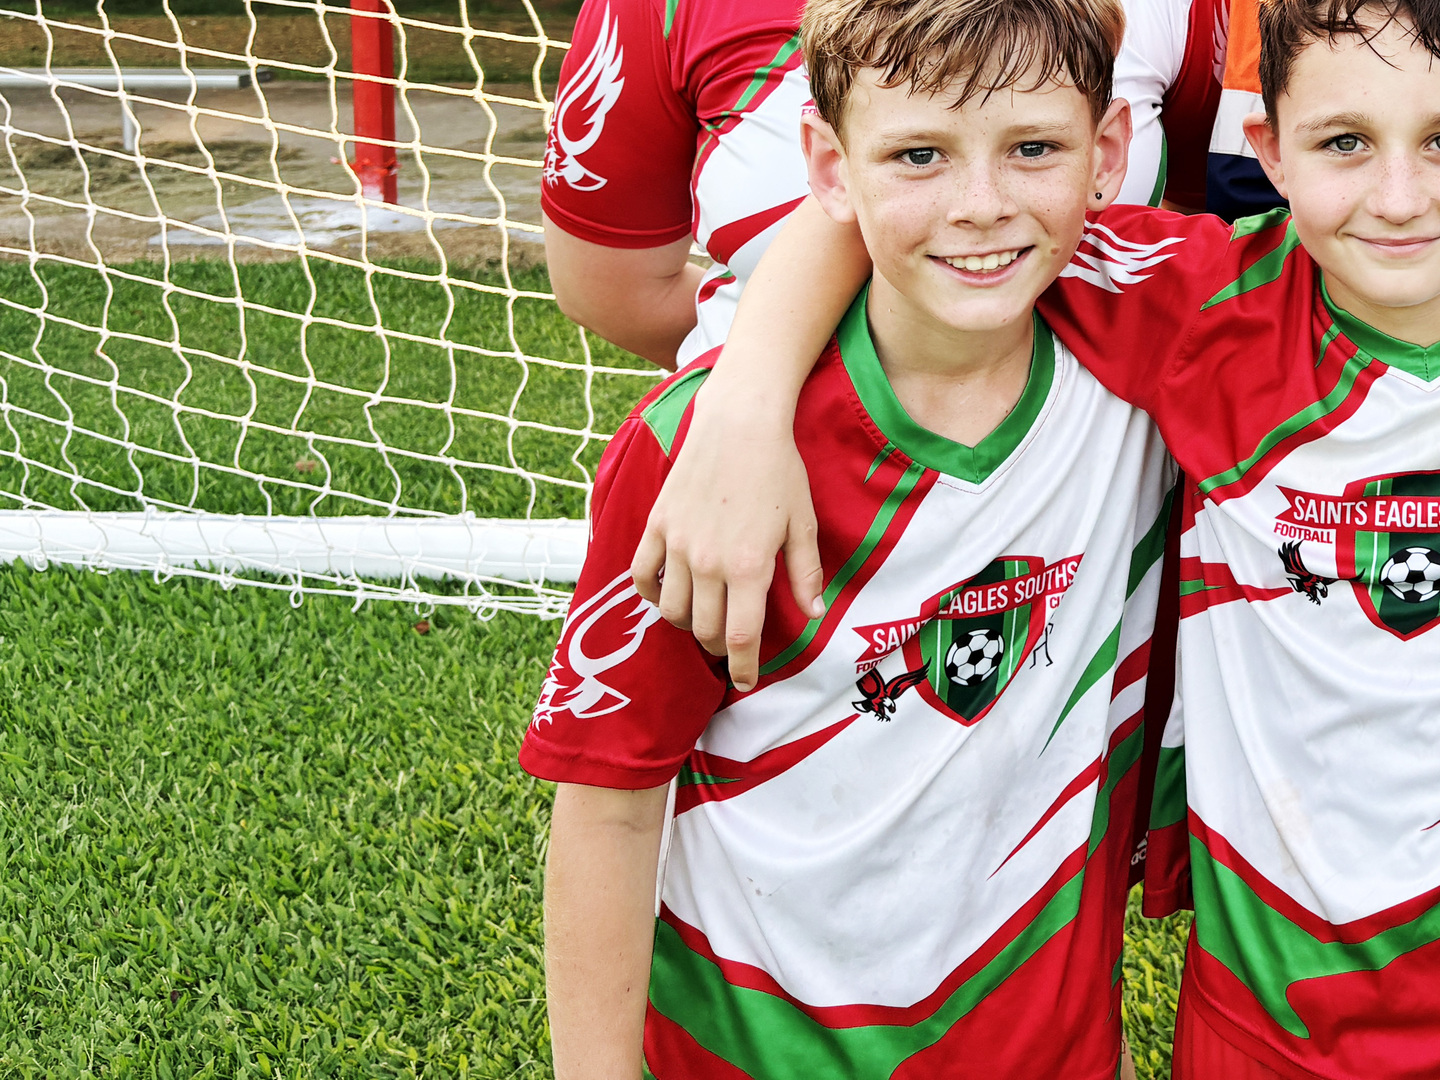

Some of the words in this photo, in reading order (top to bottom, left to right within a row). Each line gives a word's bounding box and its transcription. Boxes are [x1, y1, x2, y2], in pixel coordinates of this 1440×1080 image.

[1293, 495, 1368, 525] SAINTS
[1273, 522, 1333, 544] FOOTBALL
[1014, 560, 1079, 604] SOUTHS
